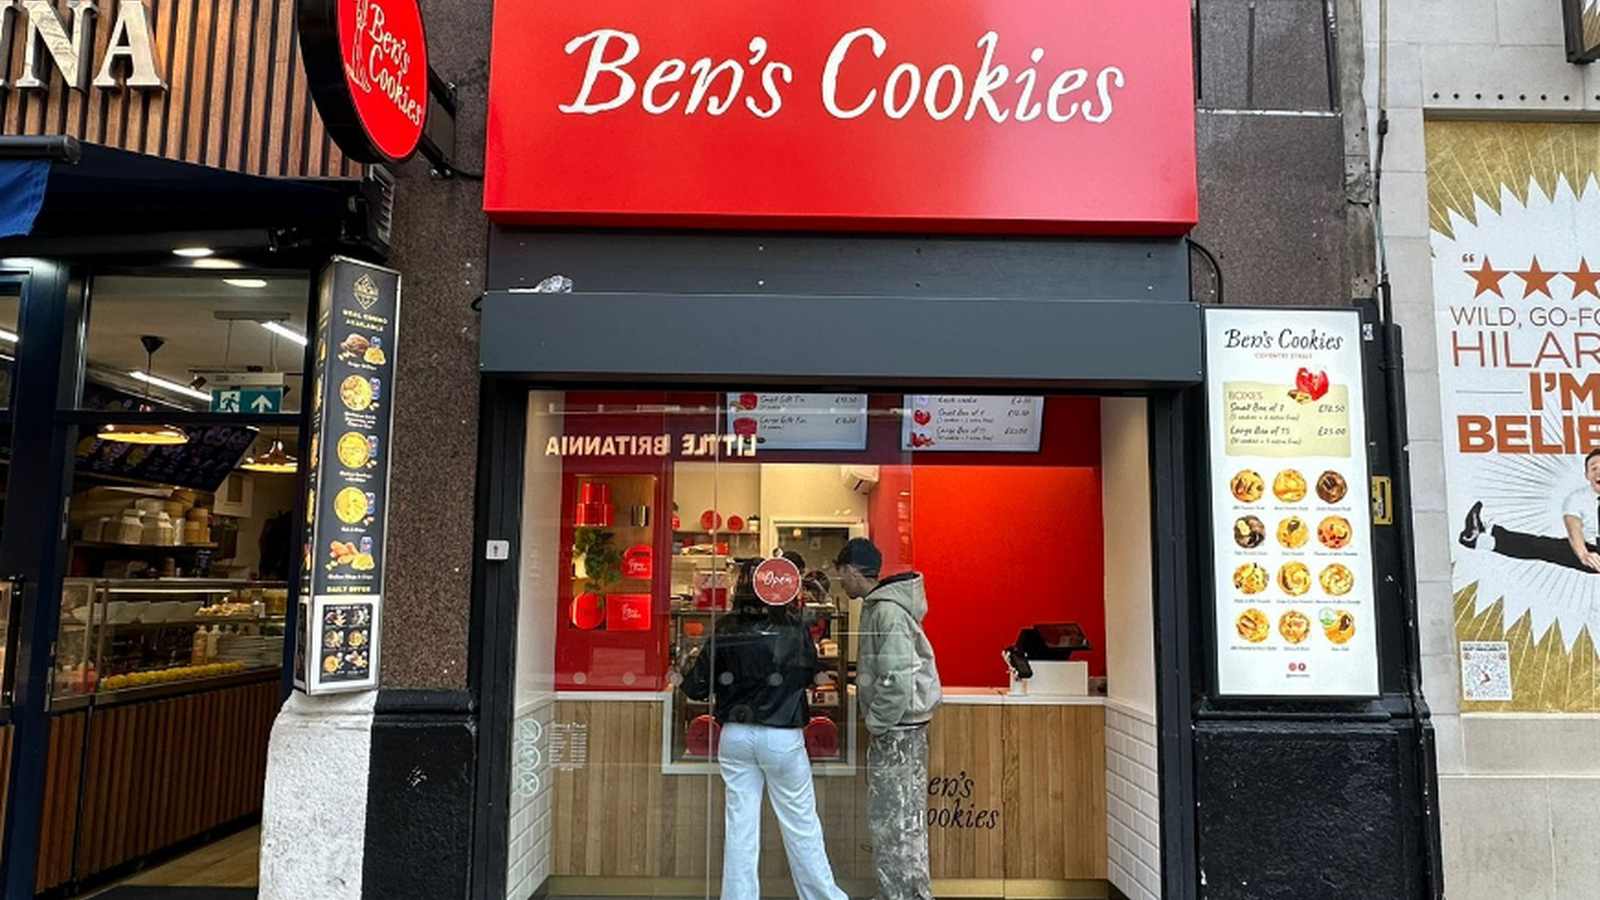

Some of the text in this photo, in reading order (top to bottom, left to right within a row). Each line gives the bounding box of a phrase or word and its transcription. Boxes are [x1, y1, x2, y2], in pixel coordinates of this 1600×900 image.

[368, 3, 410, 75] Ben's
[369, 44, 422, 126] Cookies
[557, 27, 1126, 123] Ben's Cookies
[1450, 306, 1522, 328] WILD,
[1223, 328, 1274, 349] Ben's
[1278, 328, 1344, 351] Cookies
[1452, 331, 1600, 369] HILAR
[1530, 372, 1600, 412] I'M
[1230, 425, 1252, 437] Large
[1457, 415, 1600, 454] BELIE
[763, 569, 793, 589] Open
[927, 770, 975, 798] en's
[926, 797, 1000, 830] ookies
